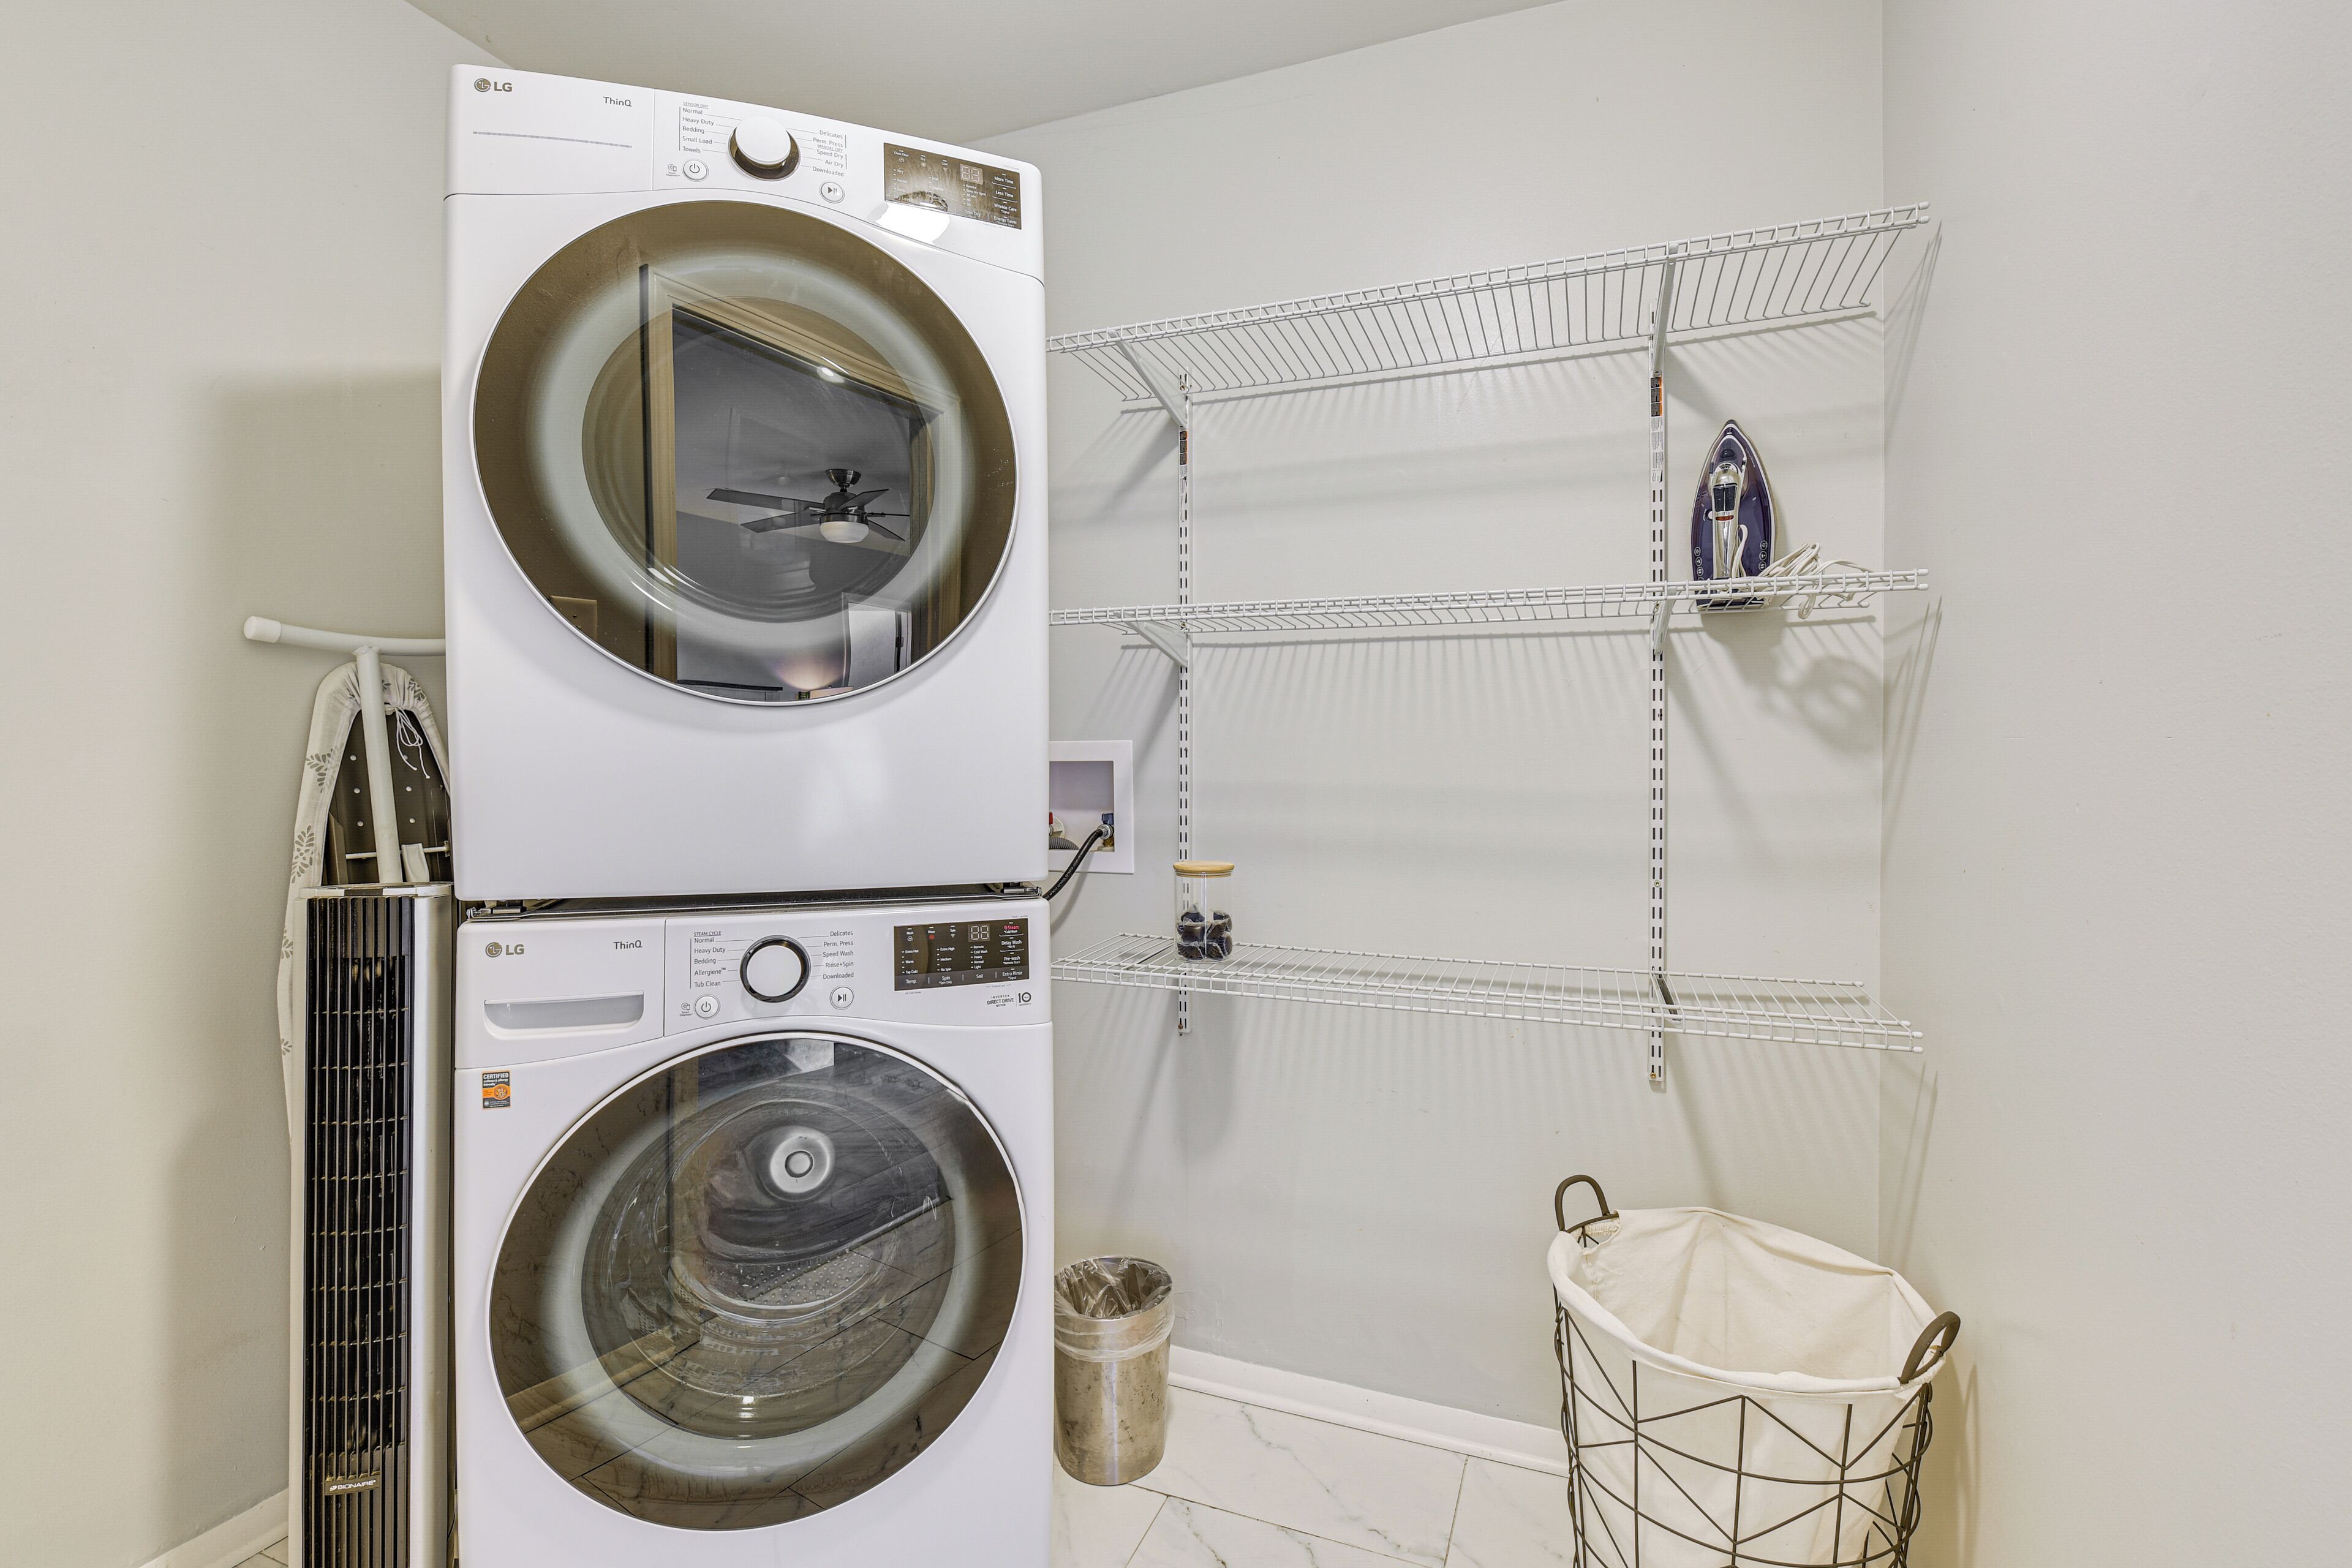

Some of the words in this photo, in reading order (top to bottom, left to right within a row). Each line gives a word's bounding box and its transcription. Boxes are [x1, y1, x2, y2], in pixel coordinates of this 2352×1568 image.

[494, 81, 513, 92] LG
[603, 96, 632, 107] ThinQ
[682, 116, 699, 125] Heavy
[682, 126, 704, 134] Bedding
[820, 130, 843, 139] Delicates
[812, 166, 844, 177] Downloaded
[613, 940, 643, 949] ThinQ
[505, 944, 525, 956] LG
[823, 971, 854, 980] Downloaded
[1018, 992, 1032, 1003] 10
[337, 1480, 374, 1490] BIONAIRE
